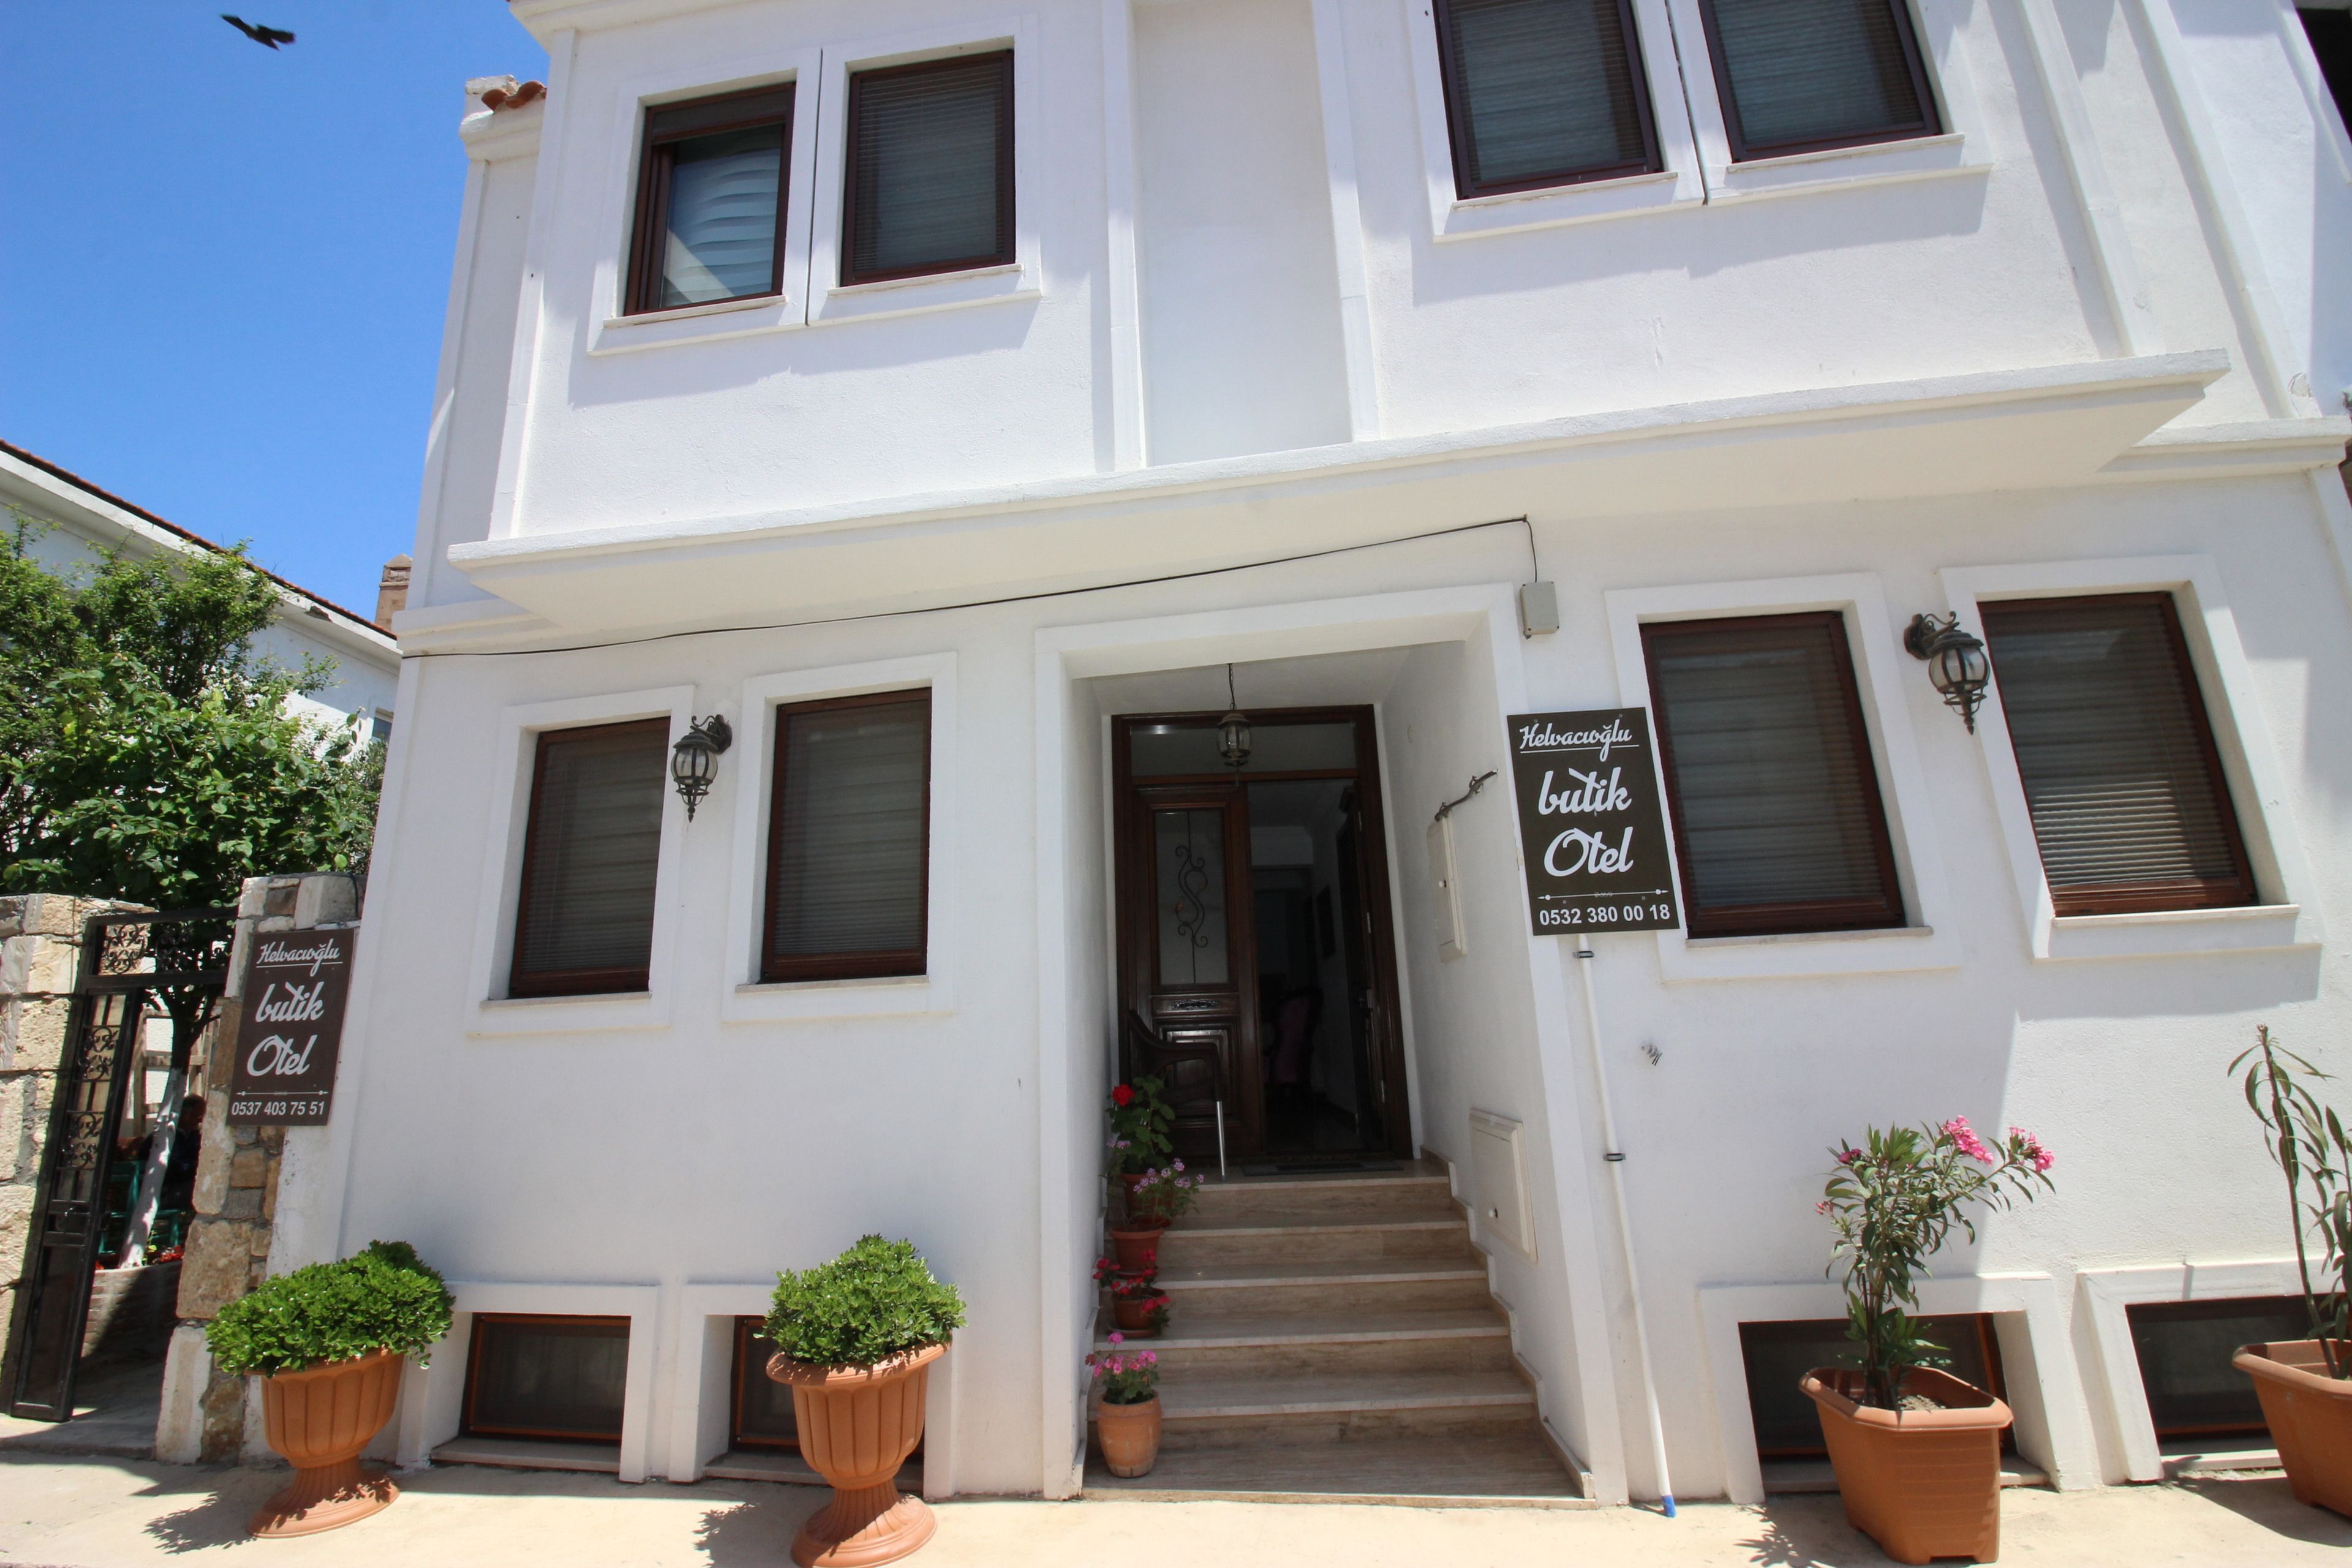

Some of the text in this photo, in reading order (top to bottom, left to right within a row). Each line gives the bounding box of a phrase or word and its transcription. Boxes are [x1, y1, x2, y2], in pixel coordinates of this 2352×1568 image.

[1538, 766, 1632, 815] butik
[1544, 826, 1634, 877] Otel
[1539, 903, 1670, 925] 0532 380 00 18
[255, 981, 325, 1023] butik
[247, 1034, 317, 1077] Otel
[231, 1101, 325, 1115] 0537 403 75 51
